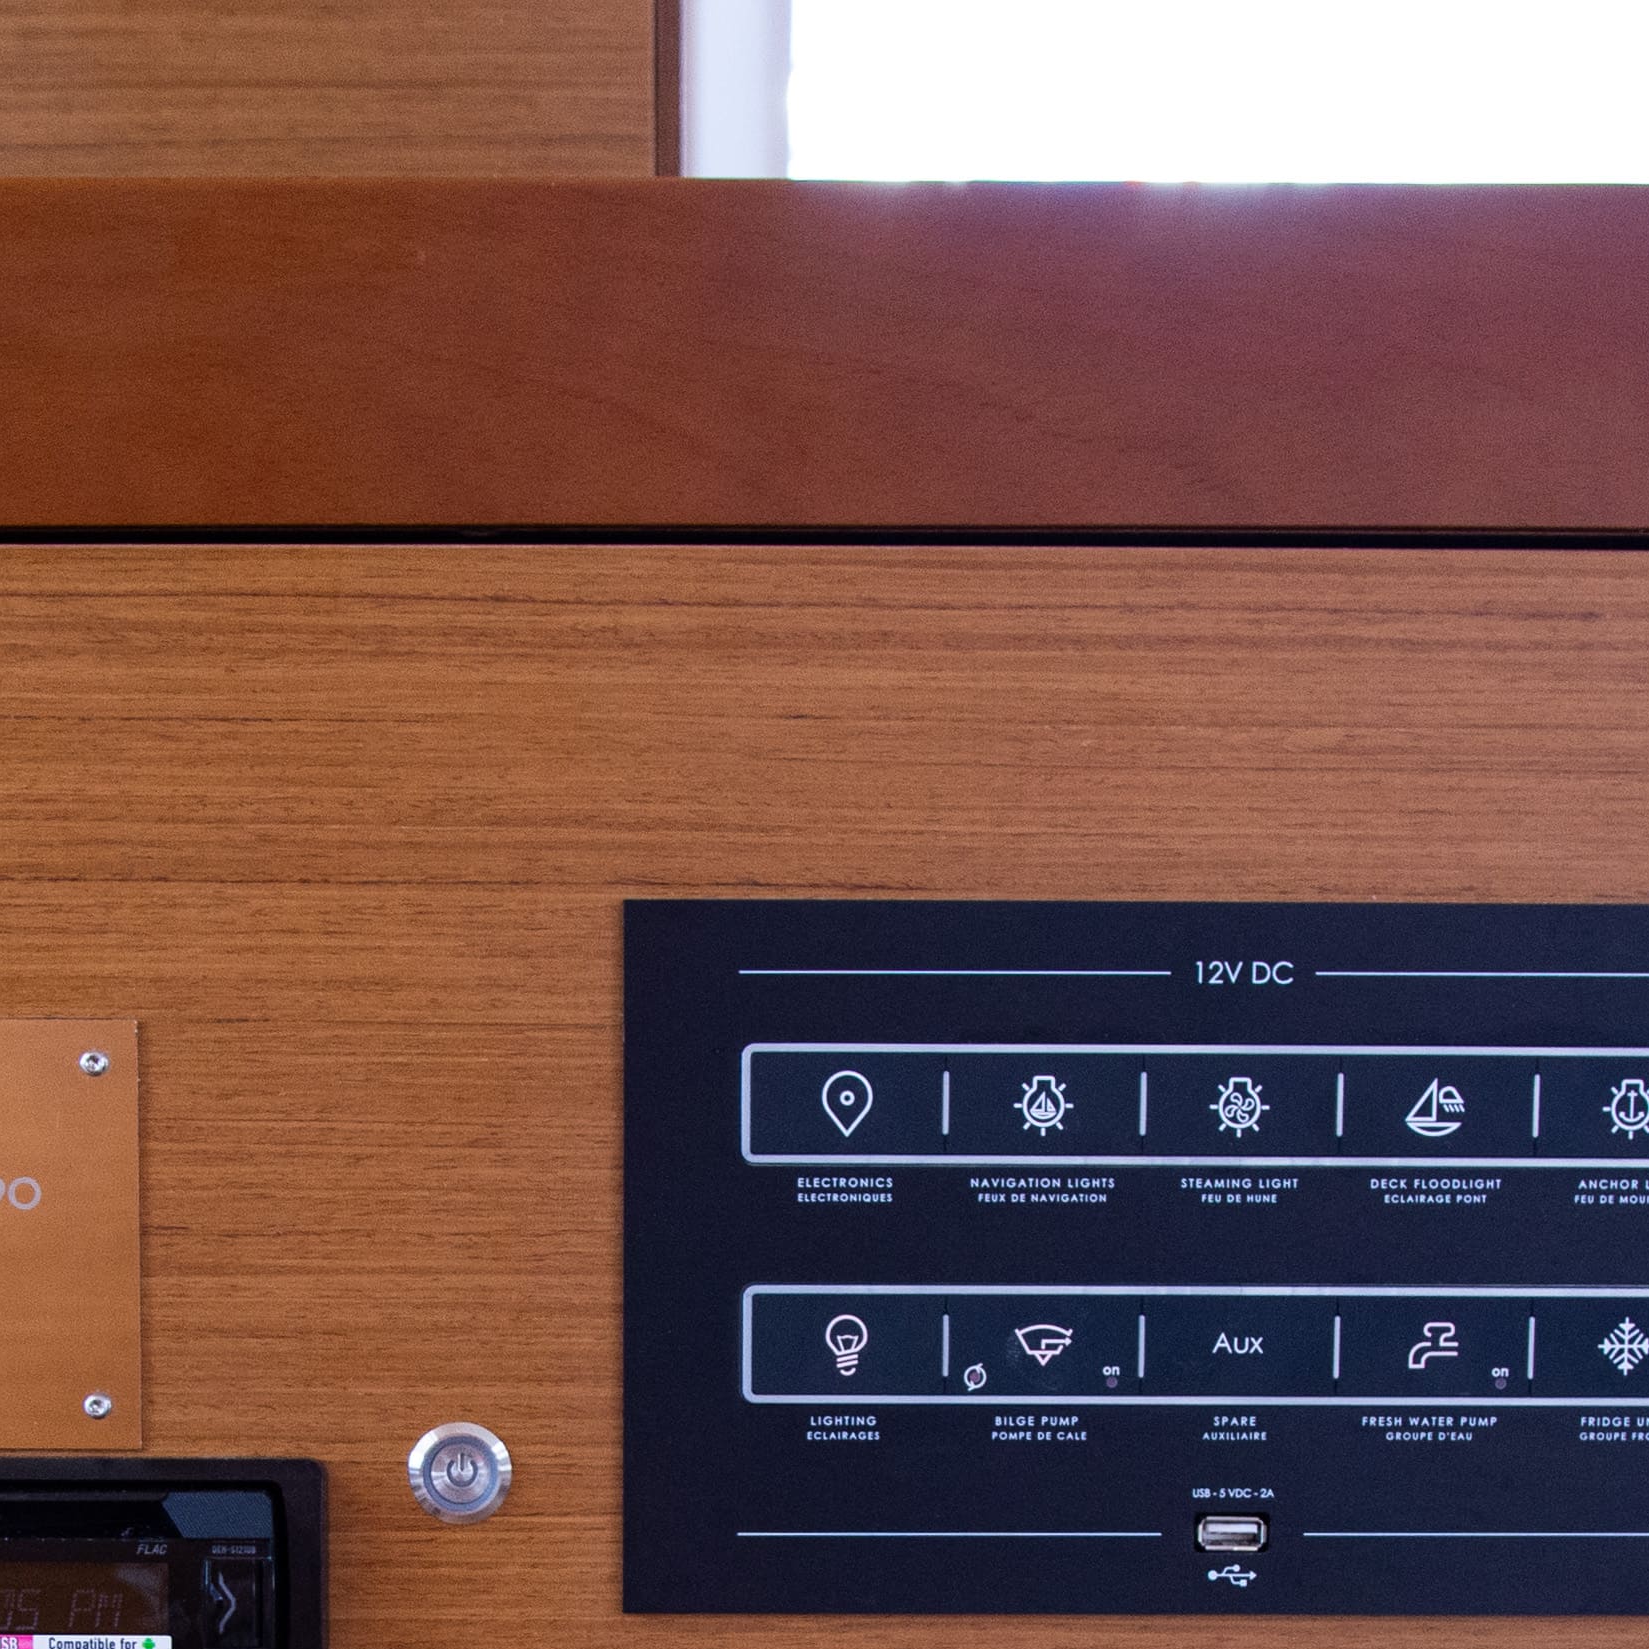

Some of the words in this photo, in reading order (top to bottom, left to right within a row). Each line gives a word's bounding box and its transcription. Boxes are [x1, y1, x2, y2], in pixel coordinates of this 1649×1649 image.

[1195, 961, 1242, 985] 12V
[1251, 961, 1295, 985] DC
[797, 1177, 893, 1188] ELECTRONICS
[970, 1177, 1061, 1189] NAVIGATION
[1067, 1177, 1115, 1189] LIGHTS
[1180, 1177, 1252, 1189] STEAMING
[1258, 1178, 1299, 1189] LIGHT
[1370, 1178, 1408, 1190] DECK
[1413, 1178, 1502, 1190] FLOODLIGHT
[1578, 1179, 1639, 1190] ANCHOR
[797, 1192, 893, 1203] ELECTRONIQUES
[977, 1193, 1006, 1203] FEUX
[1010, 1193, 1026, 1203] DE
[1030, 1193, 1107, 1203] NAVIGATION
[1201, 1193, 1222, 1203] FEU
[1226, 1193, 1242, 1204] DE
[1246, 1193, 1277, 1204] HUNE
[1384, 1194, 1451, 1204] ECLAIRAGE
[1456, 1194, 1487, 1204] PONT
[1574, 1194, 1595, 1205] FEU
[1599, 1194, 1615, 1205] DE
[1212, 1332, 1264, 1355] Aux
[1102, 1365, 1121, 1376] on
[1491, 1367, 1510, 1378] on
[810, 1415, 877, 1427] LIGHTING
[994, 1415, 1035, 1427] BILGE
[1041, 1415, 1079, 1427] PUMP
[1213, 1415, 1256, 1427] SPARE
[1361, 1416, 1403, 1427] FRESH
[1408, 1416, 1454, 1427] WATER
[1460, 1416, 1498, 1427] PUMP
[1580, 1416, 1631, 1428] FRIDGE
[806, 1431, 880, 1441] ECLAIRAGES
[991, 1431, 1032, 1441] POMPE
[1037, 1431, 1052, 1441] DE
[1056, 1431, 1087, 1441] CALE
[1202, 1431, 1267, 1441] AUXILIAIRE
[1385, 1431, 1433, 1441] GROUPE
[1438, 1431, 1473, 1441] D'EAU
[1579, 1431, 1627, 1441] GROUPE
[1193, 1488, 1210, 1498] USB
[1219, 1488, 1225, 1498] 5
[1229, 1488, 1252, 1498] VDC
[1260, 1488, 1274, 1498] 2A
[136, 1544, 167, 1555] FLAC
[120, 1638, 137, 1649] for
